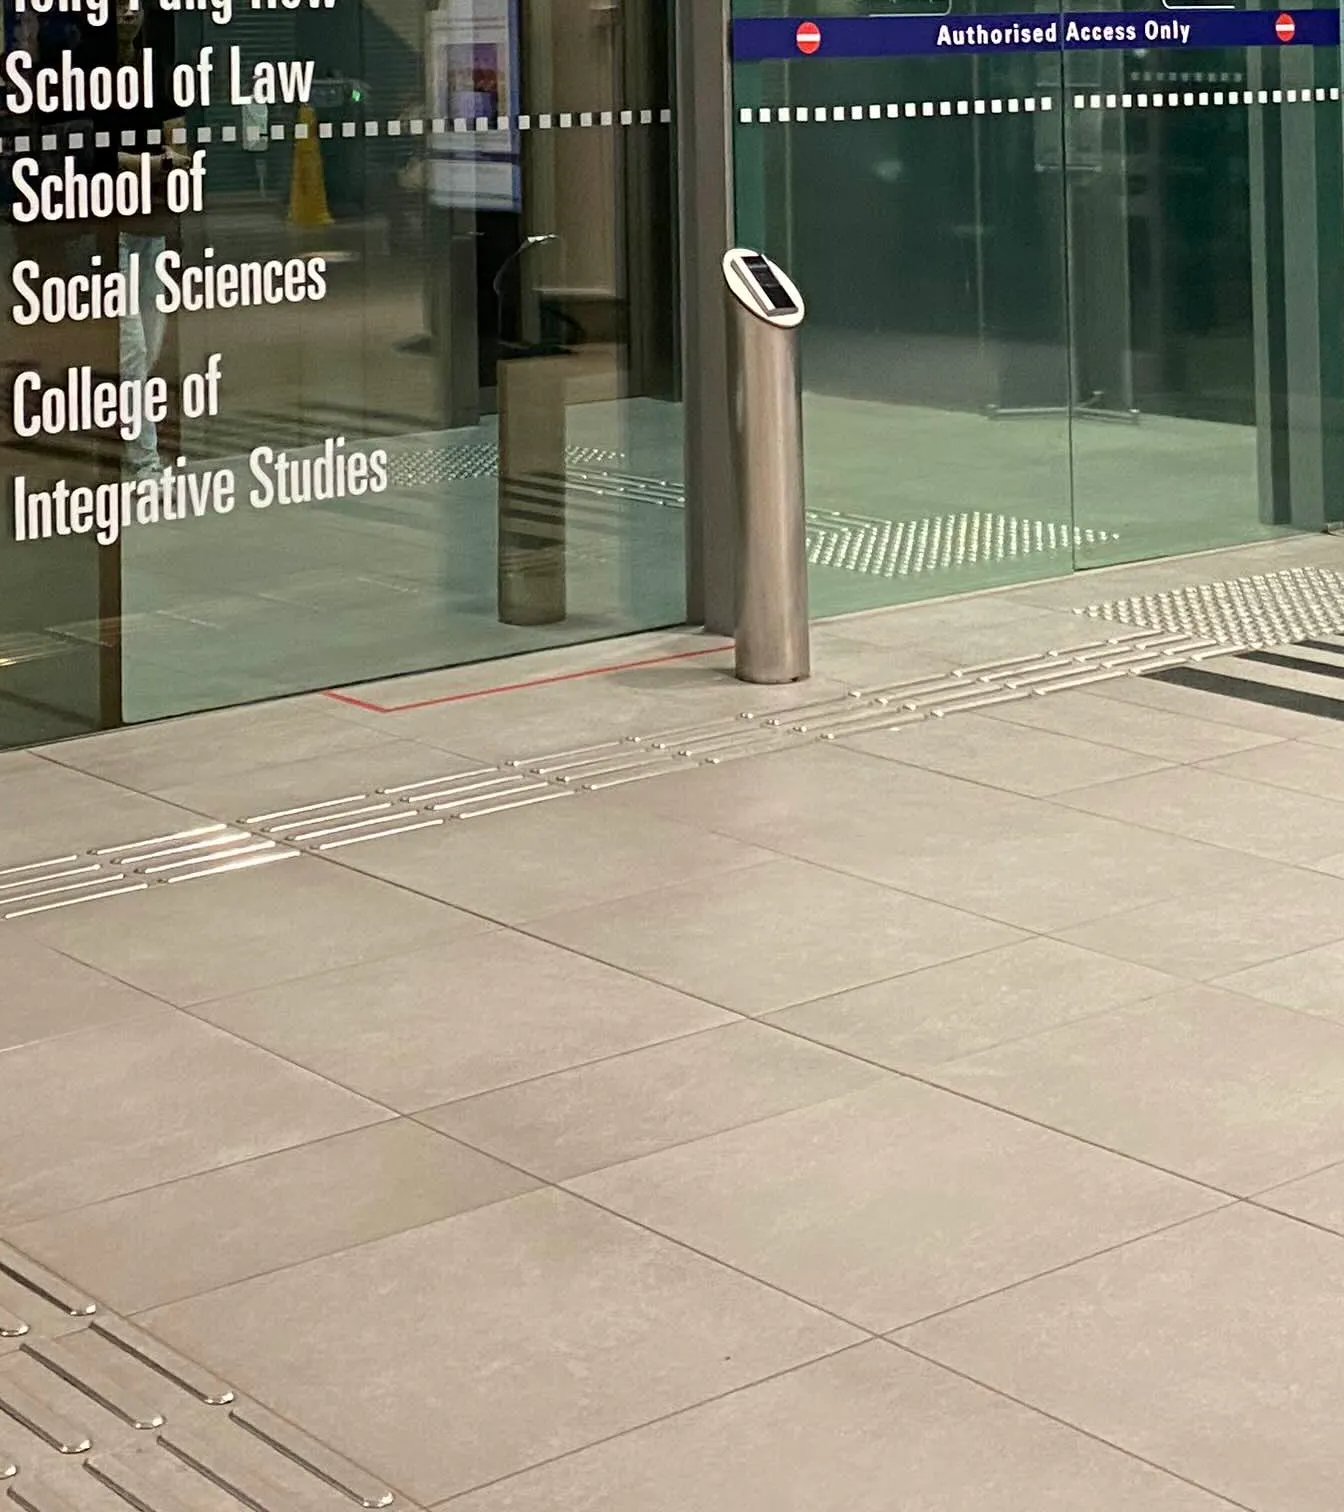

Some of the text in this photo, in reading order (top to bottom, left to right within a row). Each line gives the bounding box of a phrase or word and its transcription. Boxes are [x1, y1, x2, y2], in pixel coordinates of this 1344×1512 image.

[937, 20, 1190, 45] Authorised Access Only
[6, 45, 315, 114] School of Law
[12, 150, 206, 222] School of
[12, 248, 326, 326] Social Sciences
[13, 352, 222, 441] College of
[15, 437, 388, 546] Integrative Studies
